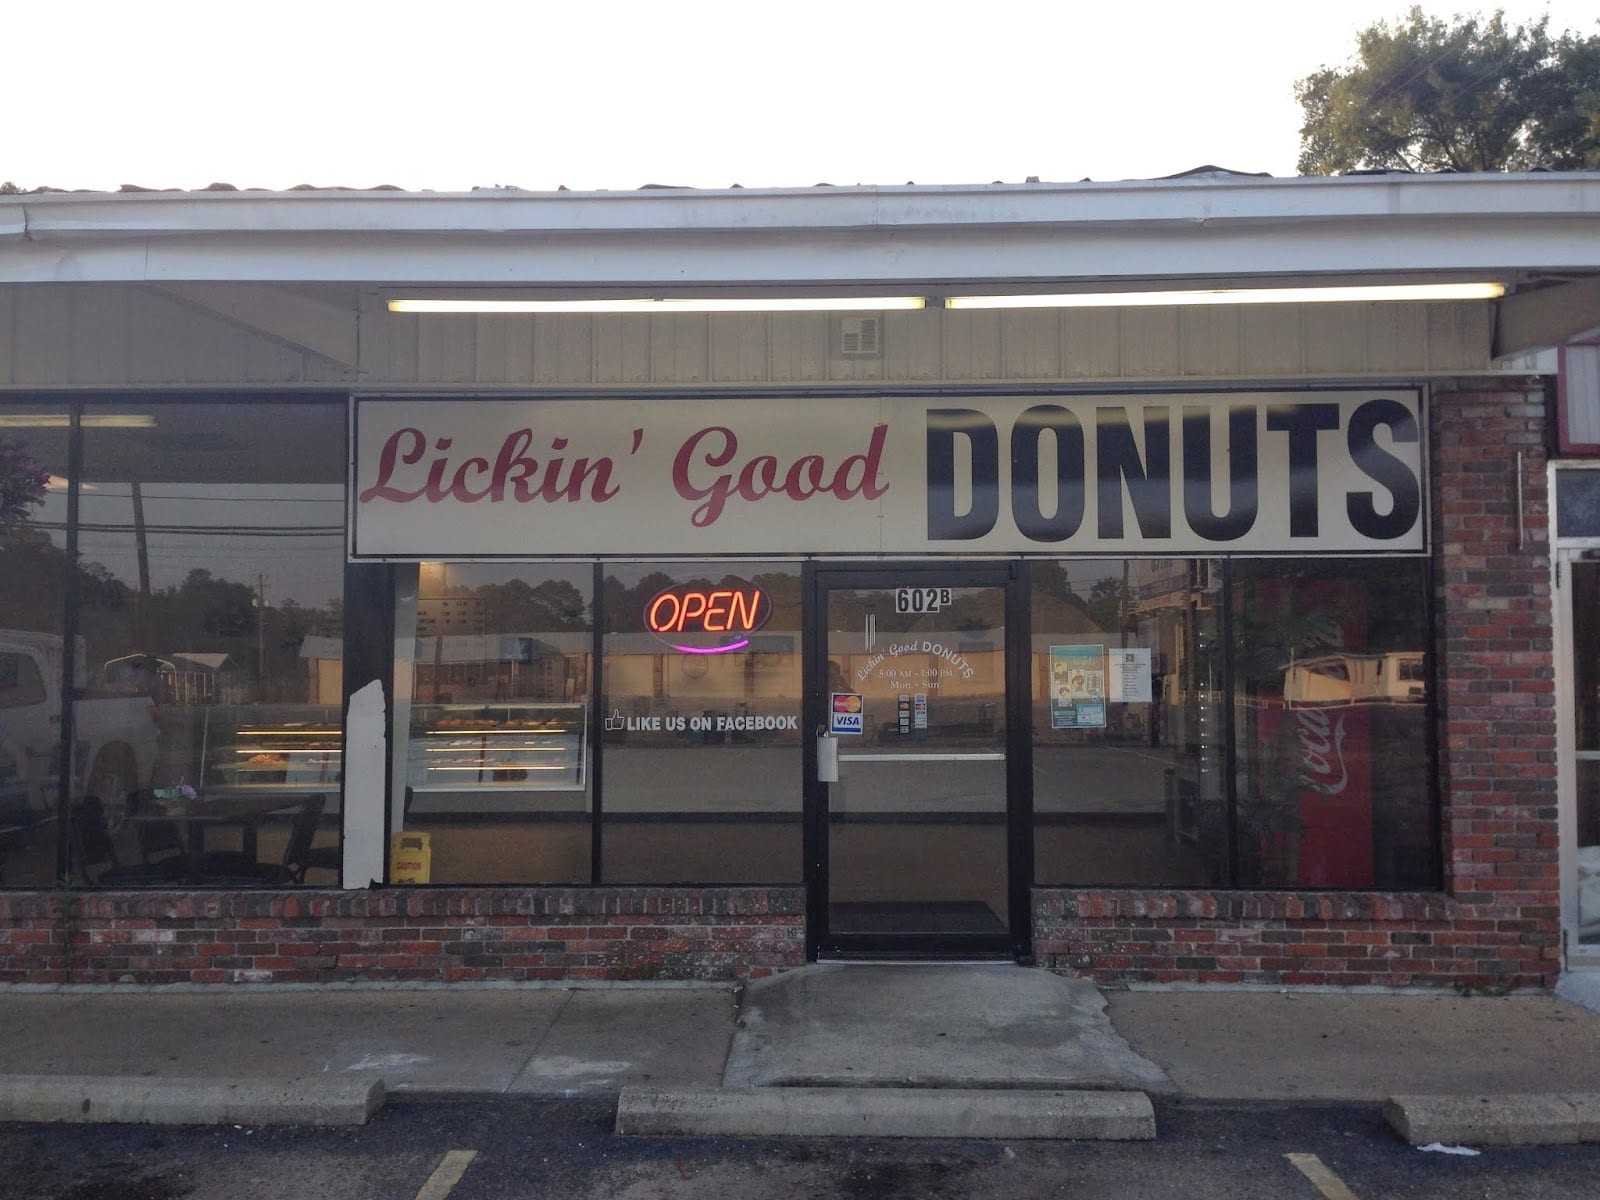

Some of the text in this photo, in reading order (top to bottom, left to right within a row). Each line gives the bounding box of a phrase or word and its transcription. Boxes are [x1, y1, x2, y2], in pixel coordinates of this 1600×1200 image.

[358, 399, 1420, 542] Lickin' Good DONUTS
[650, 589, 762, 632] OPEN
[856, 640, 974, 681] Lickin' Good DONUTS
[899, 669, 912, 678] AM
[627, 715, 798, 732] LIKE US ON FACEBOOK
[836, 716, 860, 726] VISA
